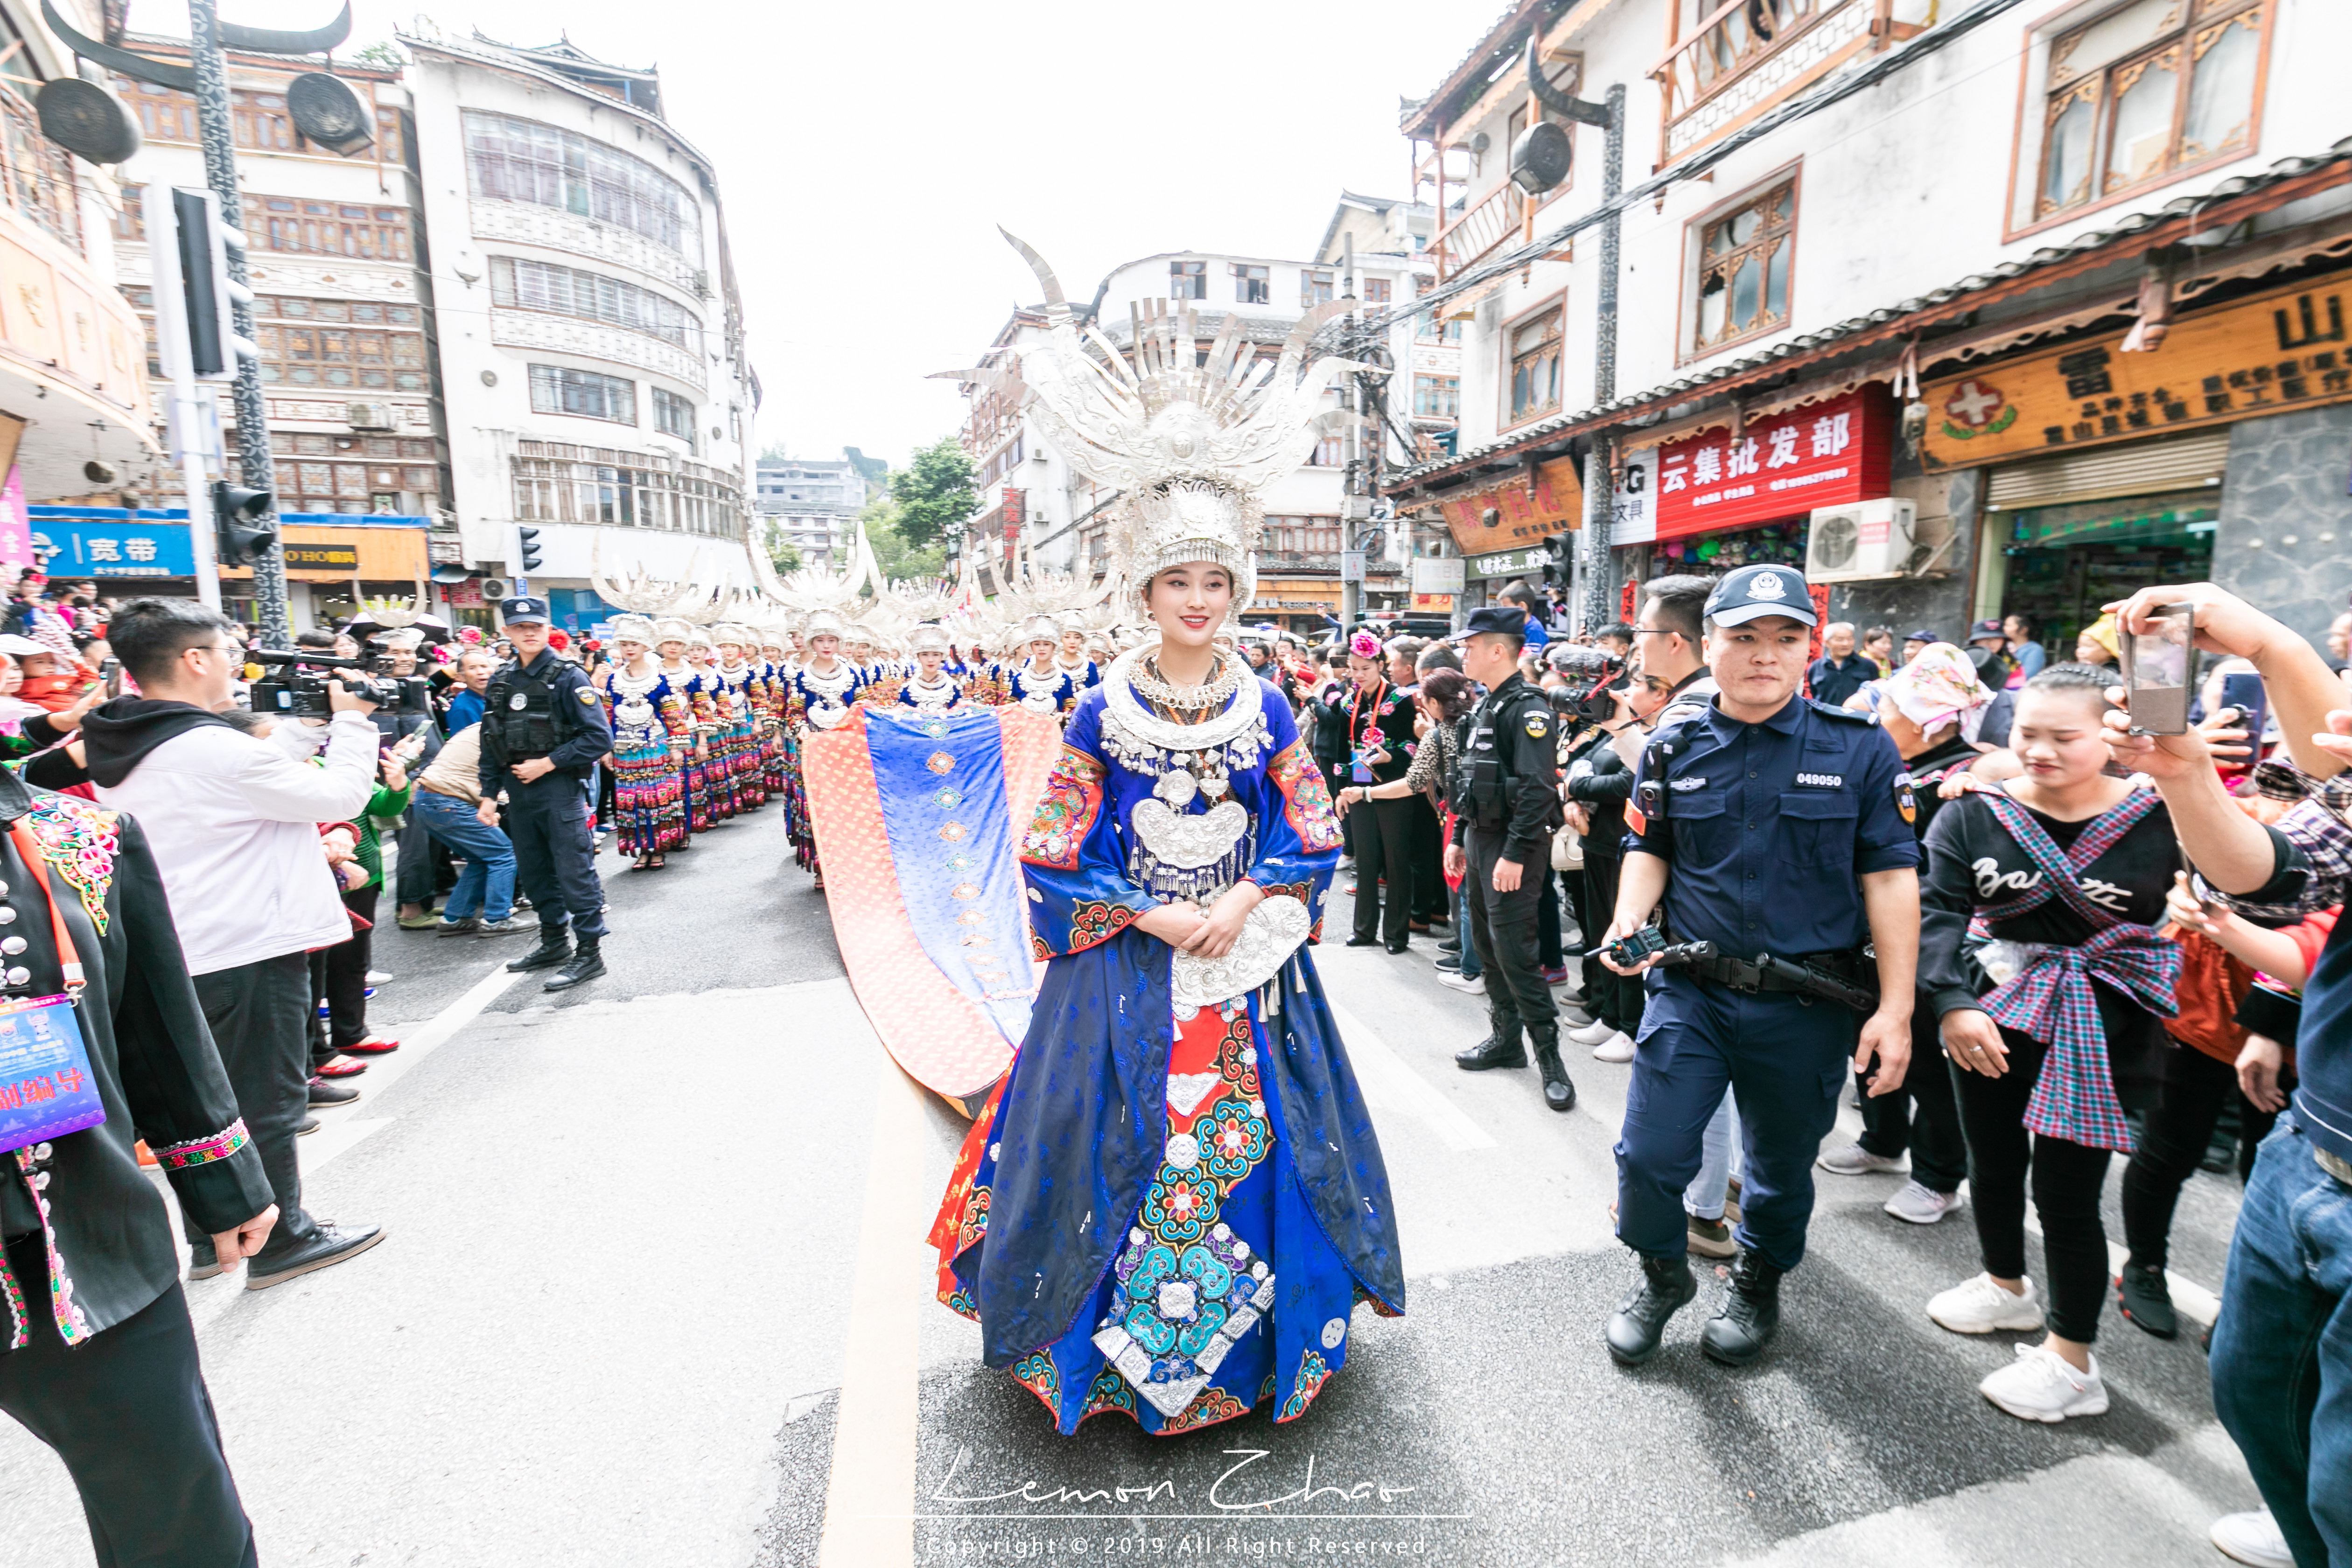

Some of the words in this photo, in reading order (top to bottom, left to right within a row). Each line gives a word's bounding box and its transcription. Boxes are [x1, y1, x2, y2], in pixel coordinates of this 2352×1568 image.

[1662, 413, 1849, 494] 云集批发部
[87, 538, 157, 562] 宽带
[1797, 773, 1842, 787] 049050
